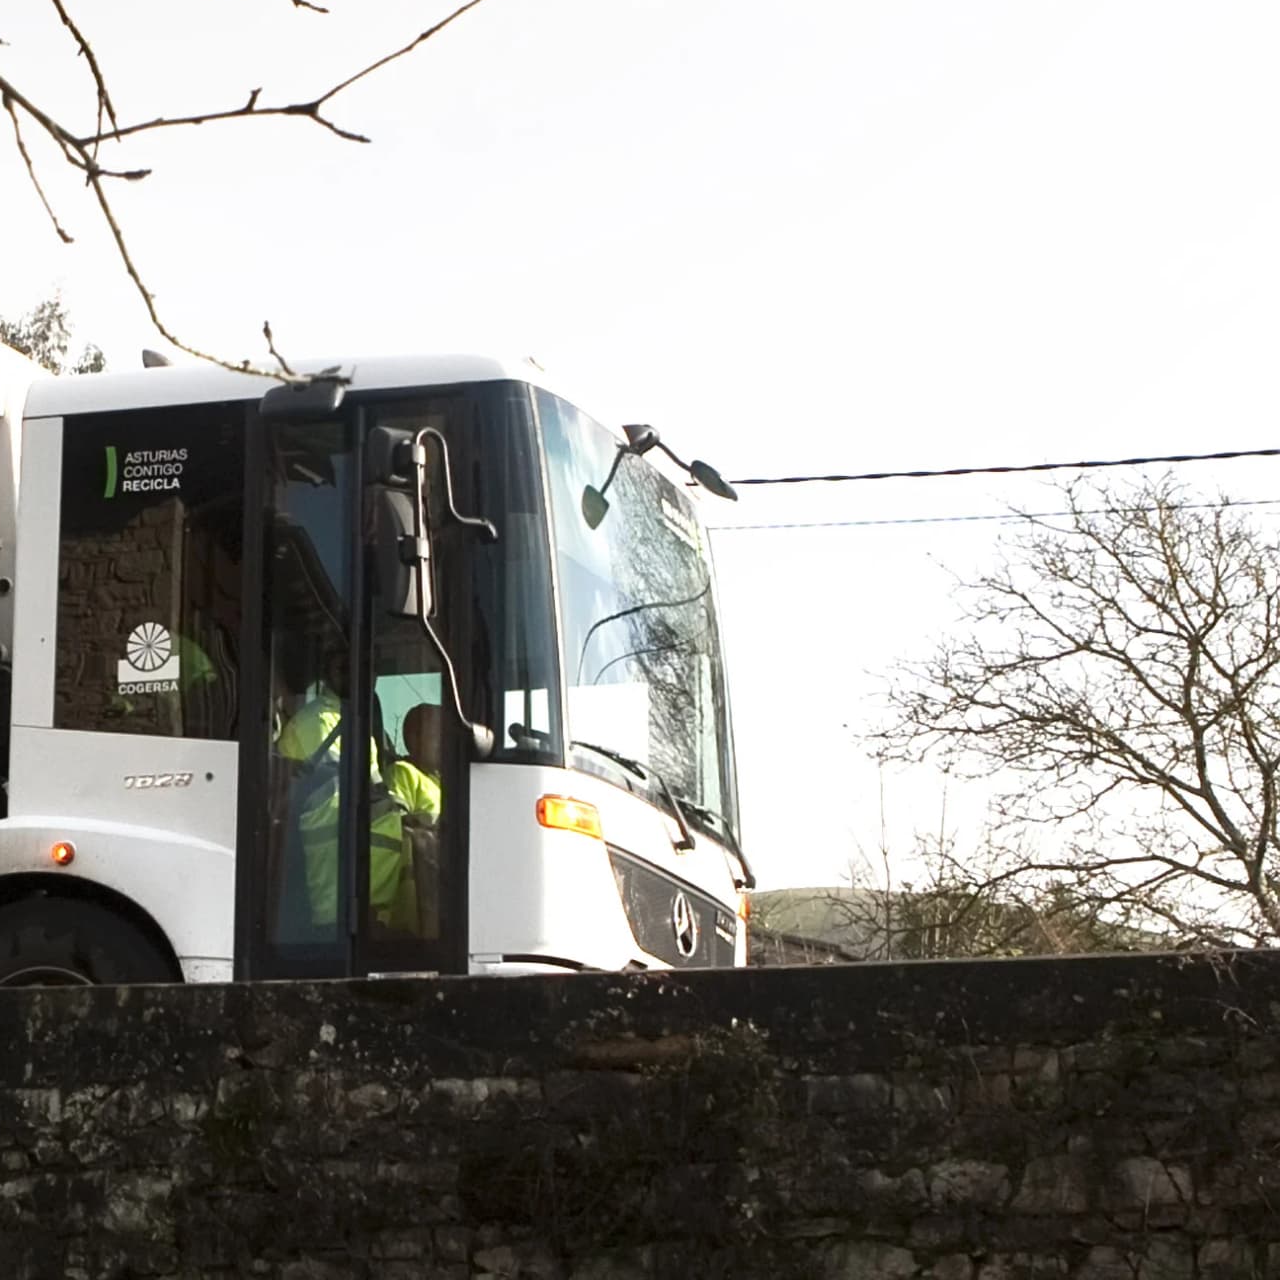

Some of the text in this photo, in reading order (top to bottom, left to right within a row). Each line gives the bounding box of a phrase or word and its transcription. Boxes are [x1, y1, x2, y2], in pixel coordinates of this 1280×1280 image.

[124, 448, 188, 464] ASTURIAS
[123, 463, 183, 478] CONTIGO
[122, 477, 181, 492] RECICLA
[118, 681, 179, 695] COGERSA
